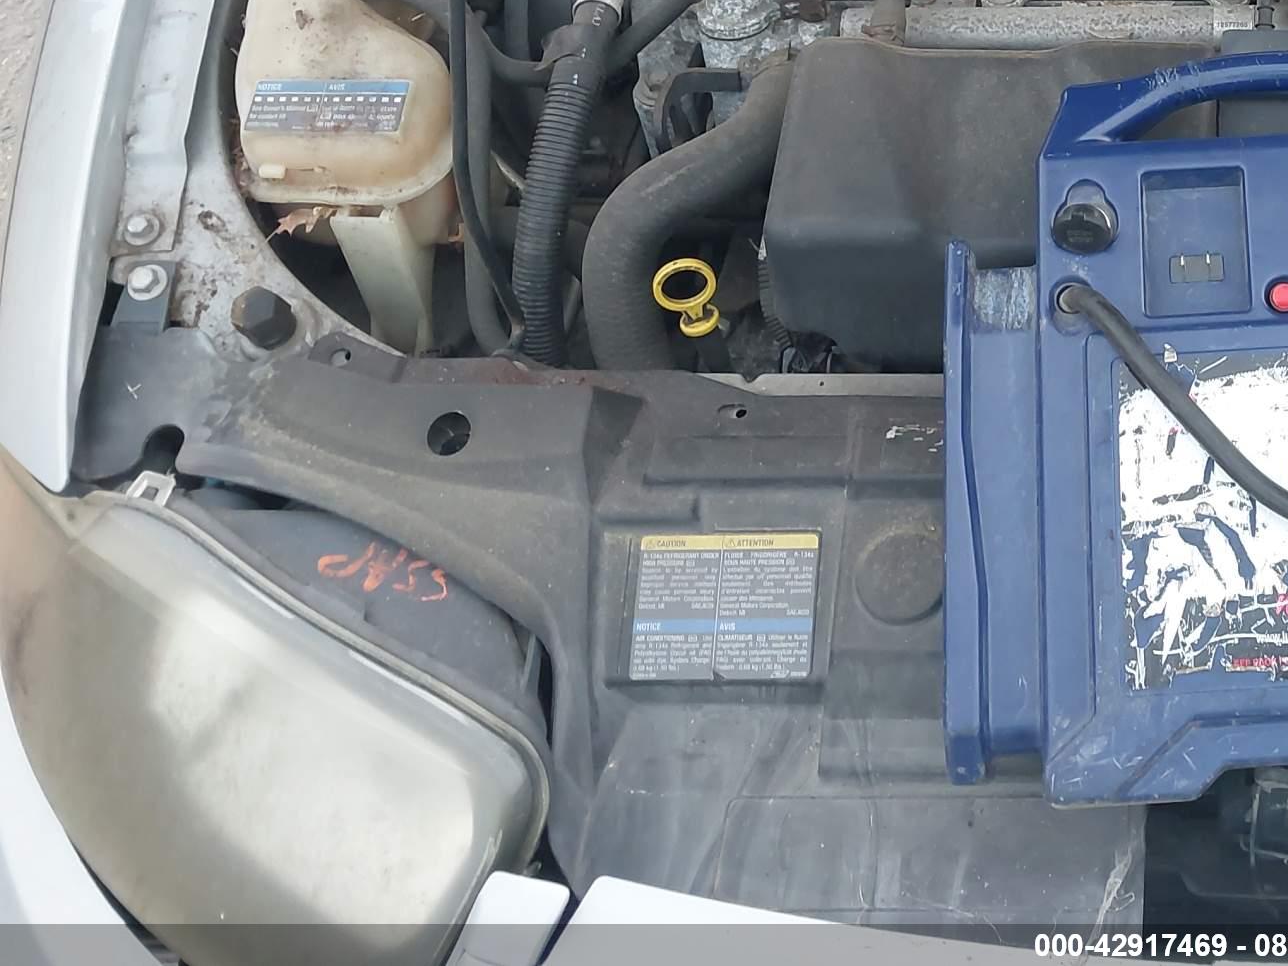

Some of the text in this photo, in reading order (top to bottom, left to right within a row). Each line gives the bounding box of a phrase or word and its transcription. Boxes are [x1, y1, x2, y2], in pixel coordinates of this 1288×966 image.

[736, 538, 774, 546] ATTENTION
[636, 622, 661, 631] NOTICE
[719, 622, 736, 631] AVIS
